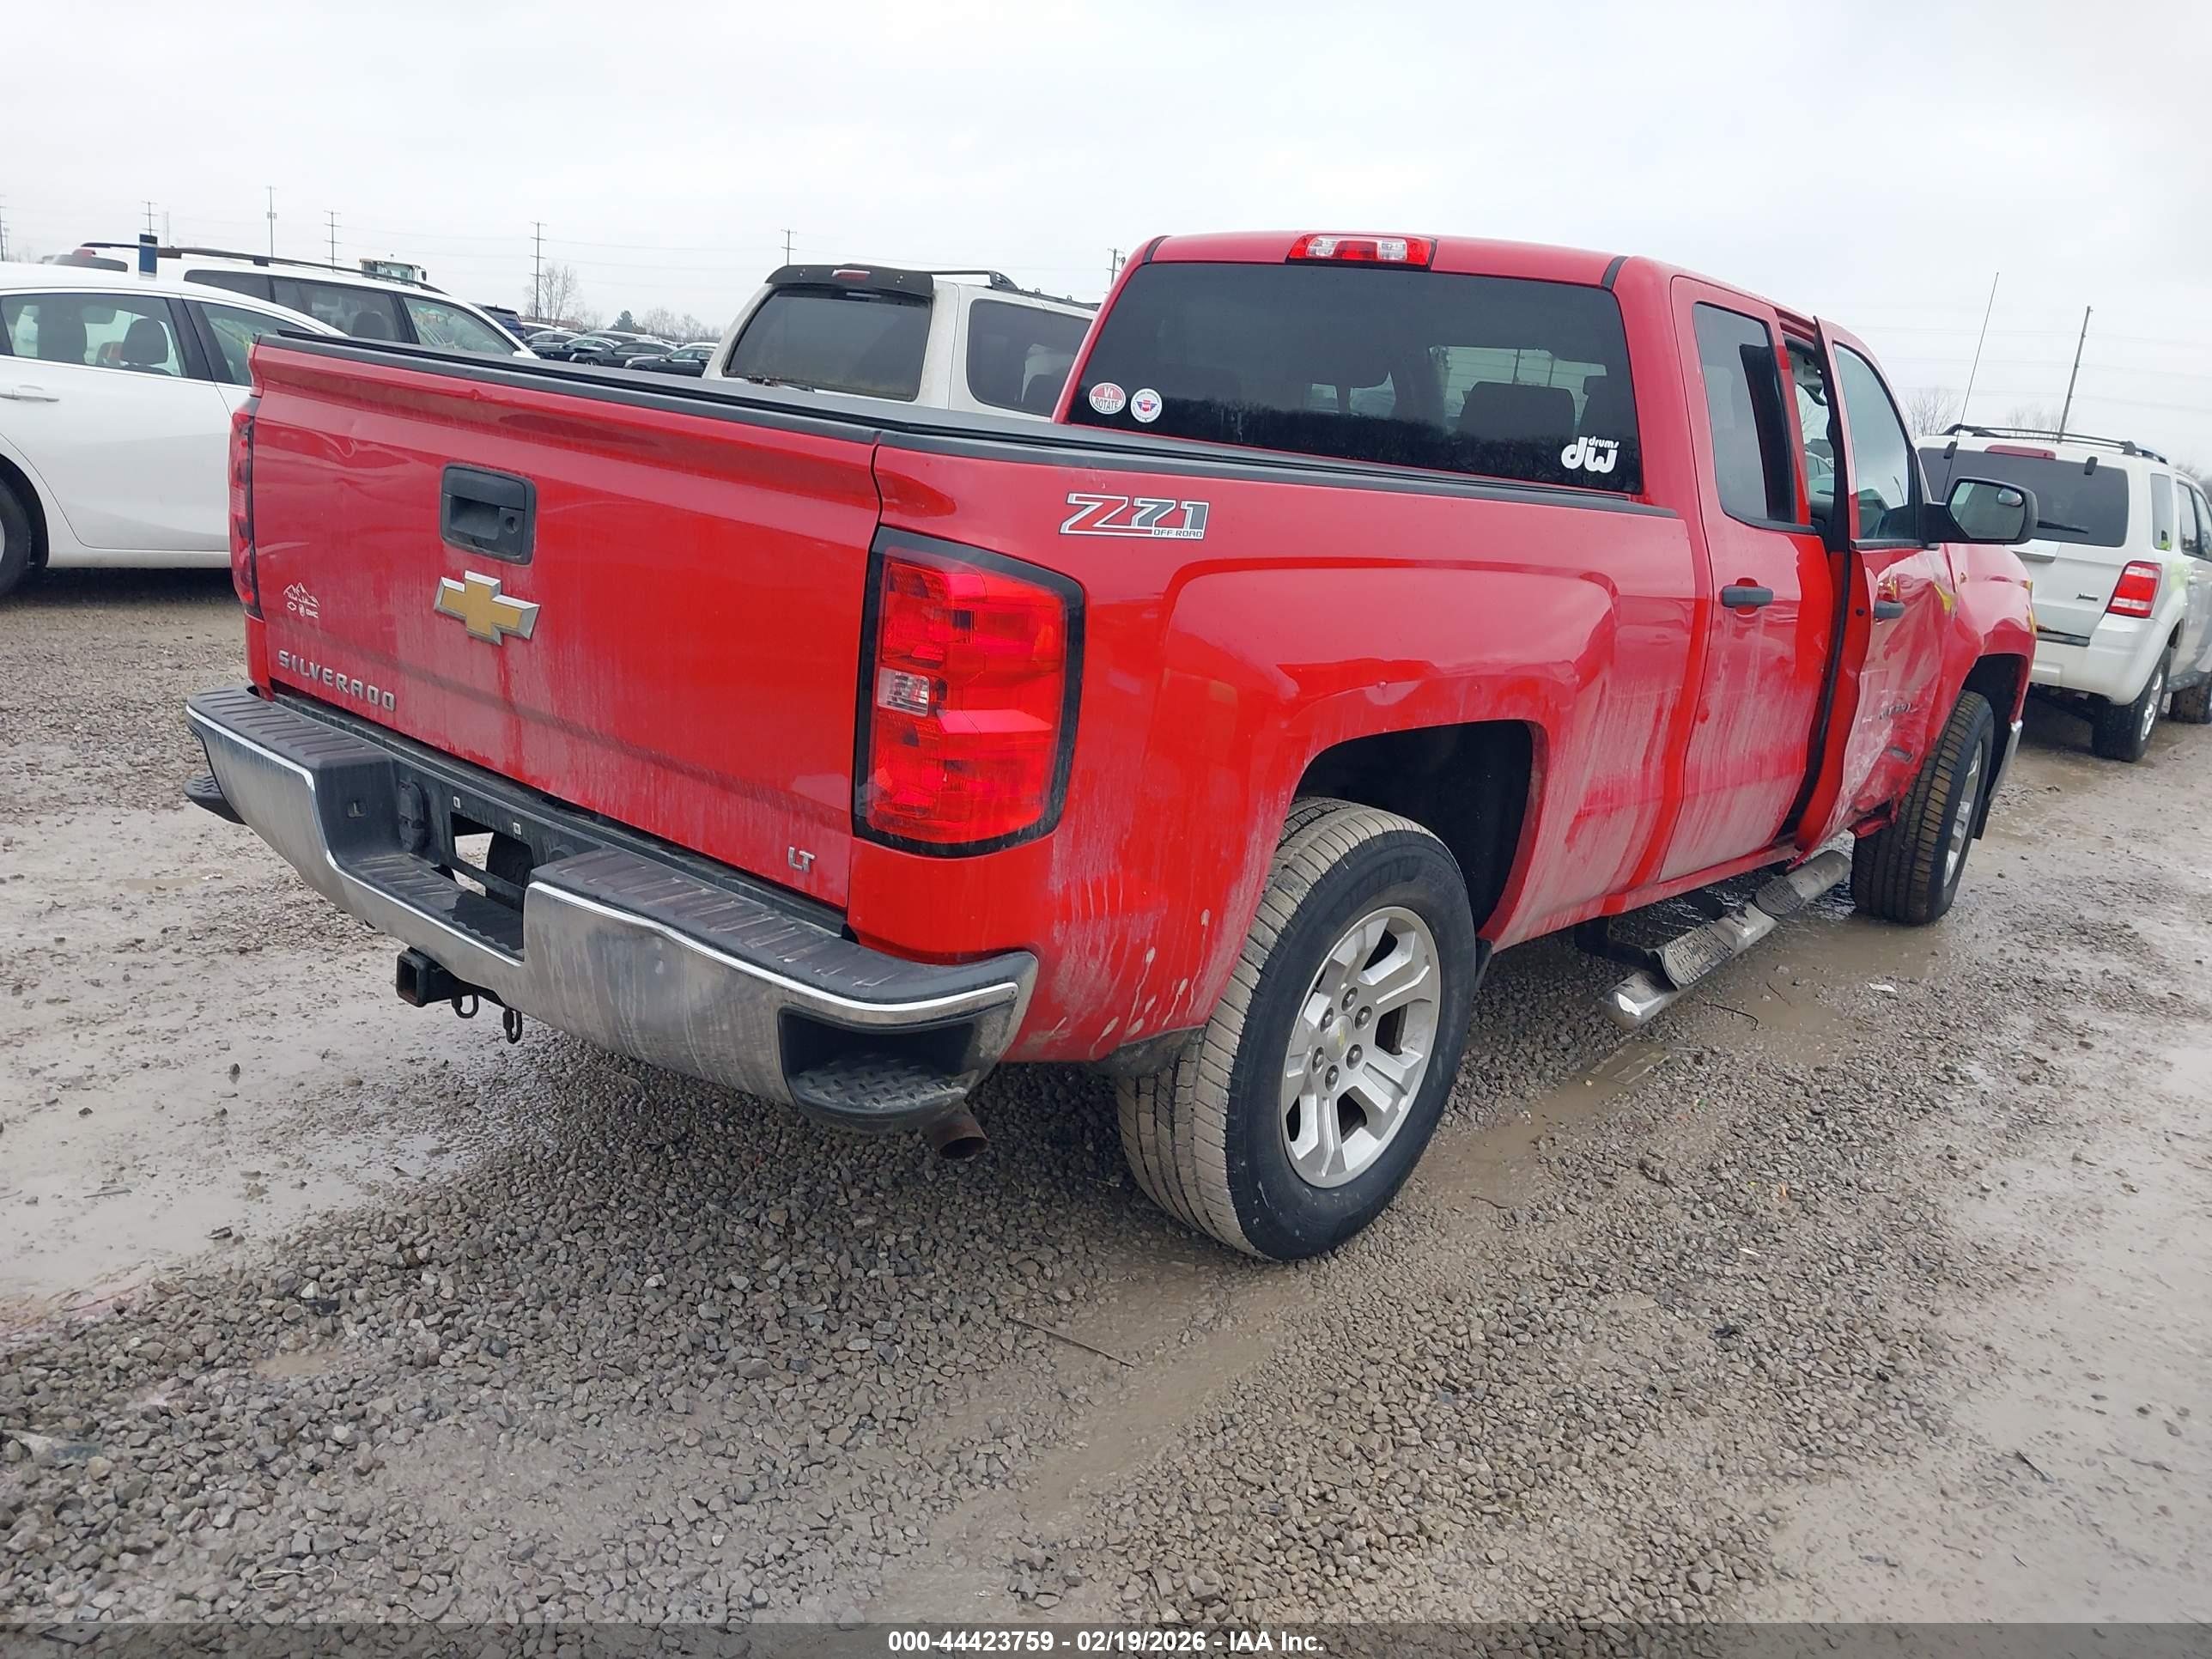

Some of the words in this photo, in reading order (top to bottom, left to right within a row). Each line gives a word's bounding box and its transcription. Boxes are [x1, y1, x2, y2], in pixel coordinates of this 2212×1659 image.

[1095, 398, 1120, 411] ROTATE
[1561, 436, 1618, 473] dw
[1588, 435, 1620, 448] drums
[1059, 492, 1210, 539] Z71
[278, 649, 396, 712] SILVERADO
[788, 846, 815, 872] LT
